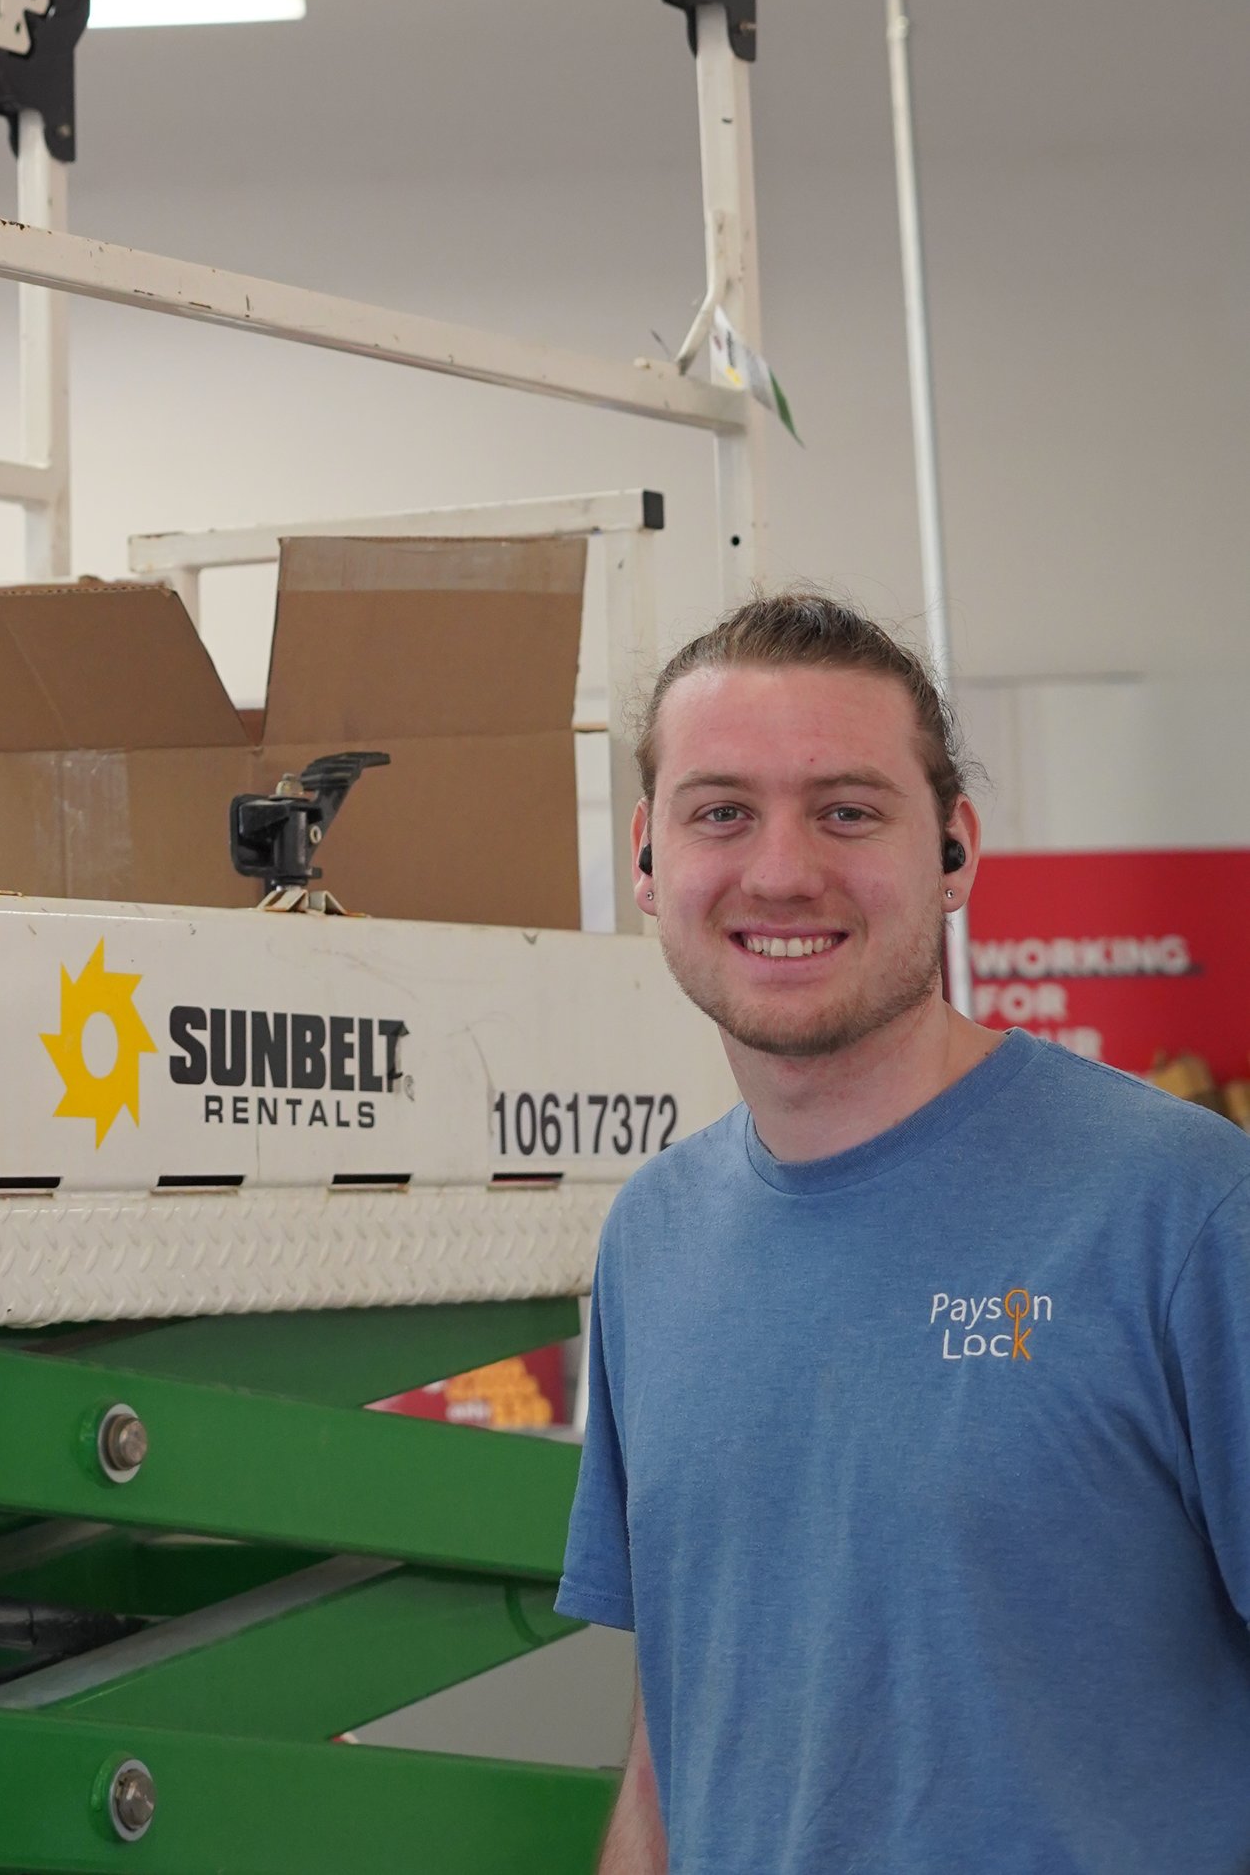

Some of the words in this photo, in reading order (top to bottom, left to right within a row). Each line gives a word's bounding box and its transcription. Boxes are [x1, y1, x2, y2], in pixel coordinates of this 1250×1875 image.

[969, 936, 1189, 977] WORKING
[973, 983, 1067, 1023] FOR
[169, 1005, 407, 1093] SUNBELT
[205, 1094, 375, 1128] RENTALS
[493, 1091, 678, 1155] 10617372
